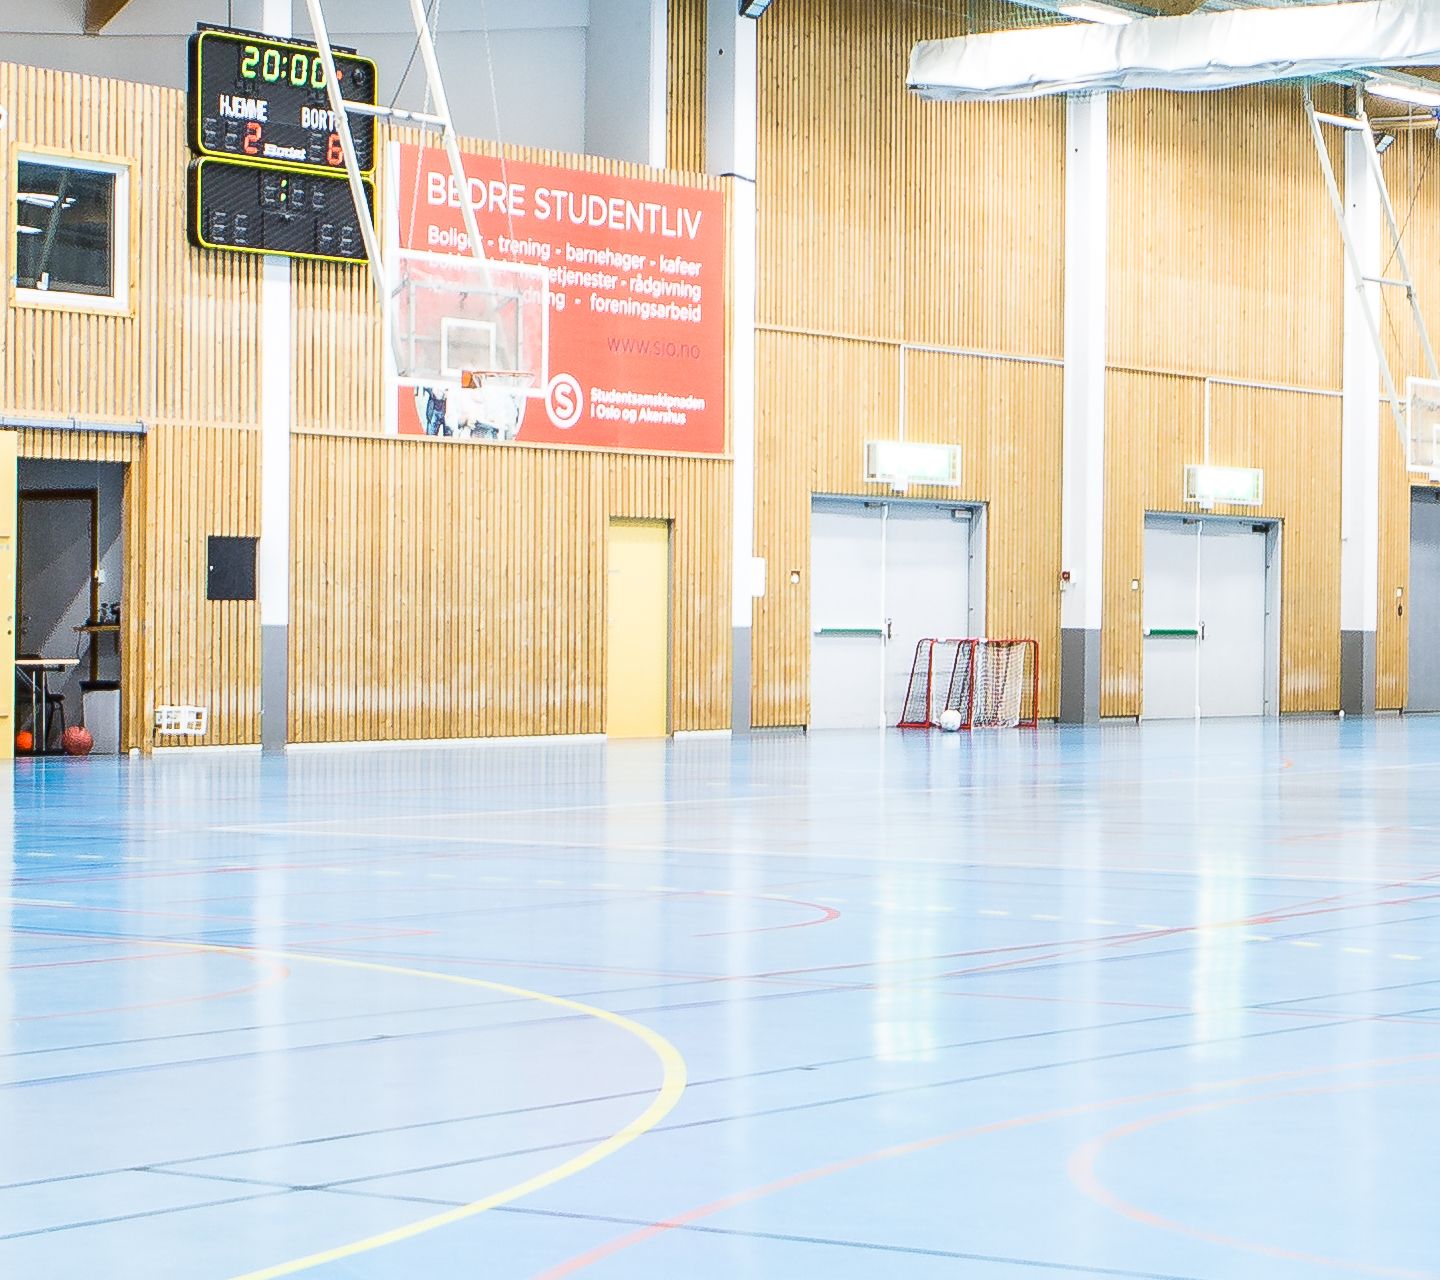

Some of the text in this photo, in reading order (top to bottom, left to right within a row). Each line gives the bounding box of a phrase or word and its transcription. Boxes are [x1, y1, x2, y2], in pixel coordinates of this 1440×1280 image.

[241, 45, 328, 90] 20:00
[219, 94, 269, 122] HJEMME
[301, 106, 339, 132] BORT
[244, 122, 263, 155] 2
[426, 171, 702, 240] BEDRE STUDENTLIV
[498, 235, 551, 260] trening
[565, 242, 646, 271] barnehager
[659, 254, 702, 276] kafeer
[629, 272, 702, 302] rådgivning
[590, 293, 702, 323] foreningsarbeid
[607, 335, 701, 360] www.sio.no
[596, 403, 621, 420] Oslo
[622, 408, 637, 423] og
[638, 407, 687, 425] Akershus
